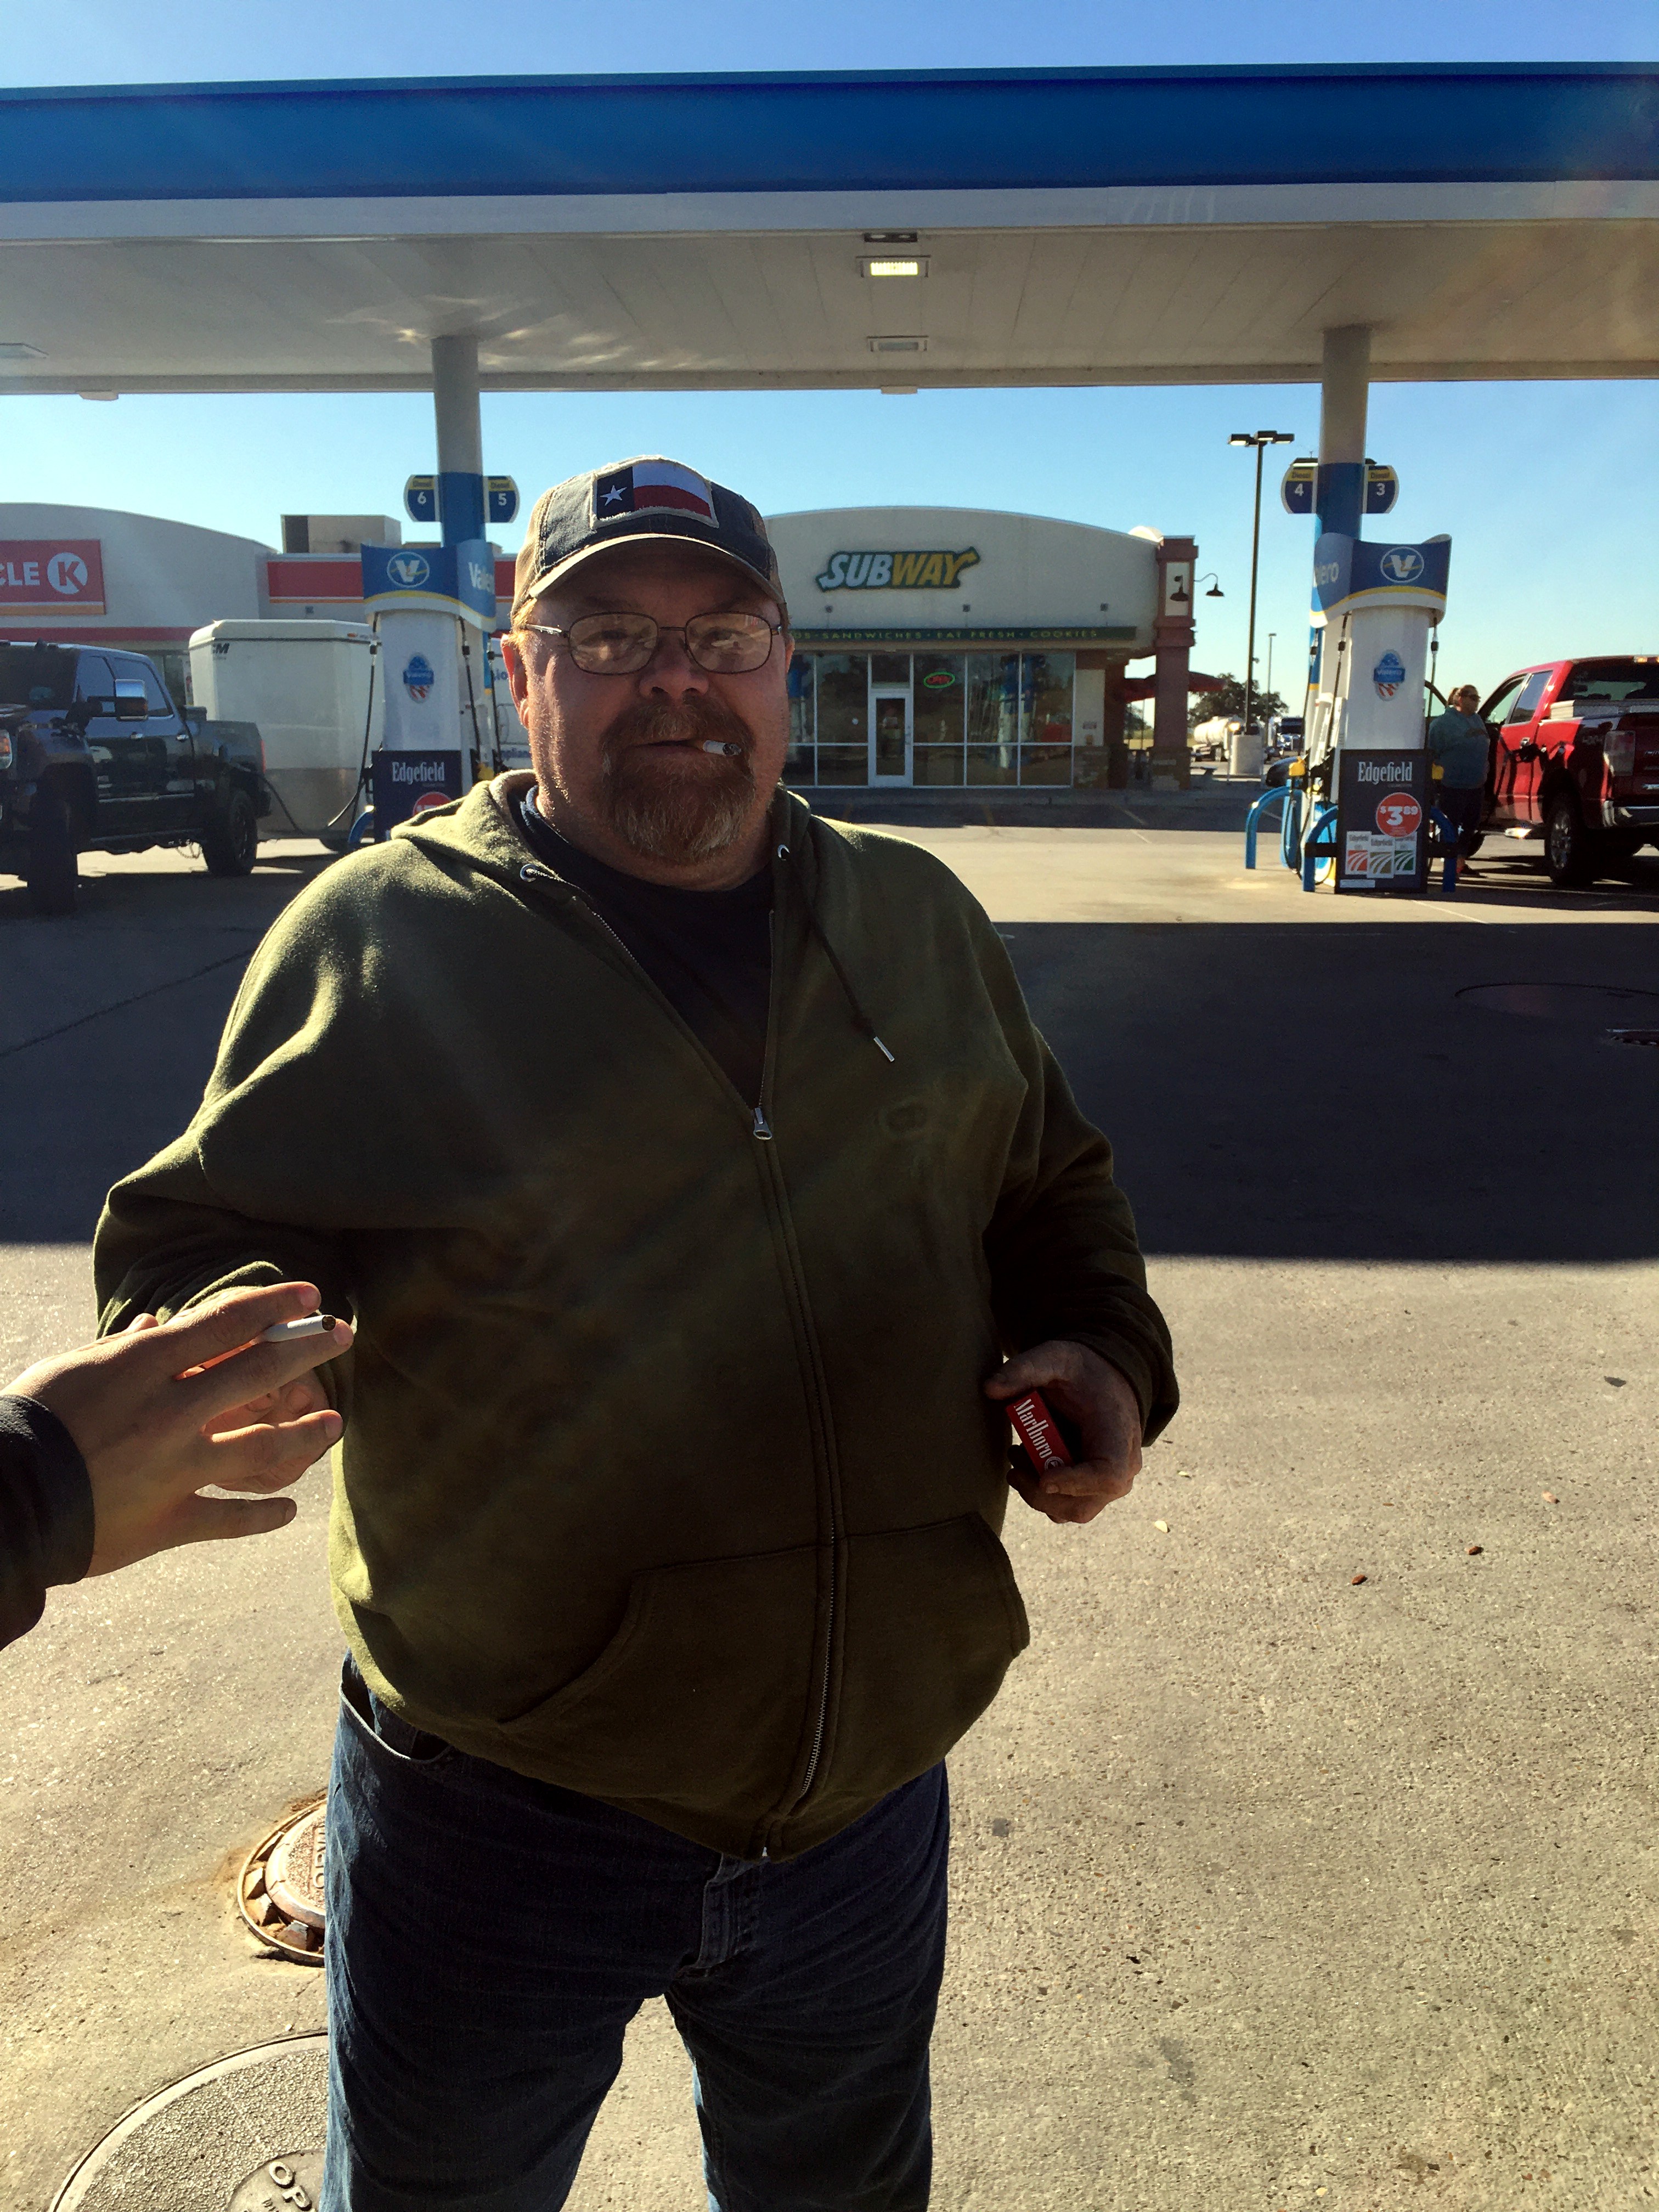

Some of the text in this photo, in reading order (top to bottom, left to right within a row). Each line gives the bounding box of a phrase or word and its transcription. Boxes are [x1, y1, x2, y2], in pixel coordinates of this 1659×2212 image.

[417, 492, 427, 505] 6
[498, 493, 507, 506] 5
[1295, 483, 1304, 496] 4
[1376, 483, 1385, 495] 3
[0, 561, 84, 591] LE K
[818, 550, 978, 589] SUBWAY
[392, 761, 445, 785] Edgefield
[1358, 761, 1413, 785] Edgefield
[1014, 1398, 1052, 1458] Marlboro
[269, 2160, 314, 2212] OP
